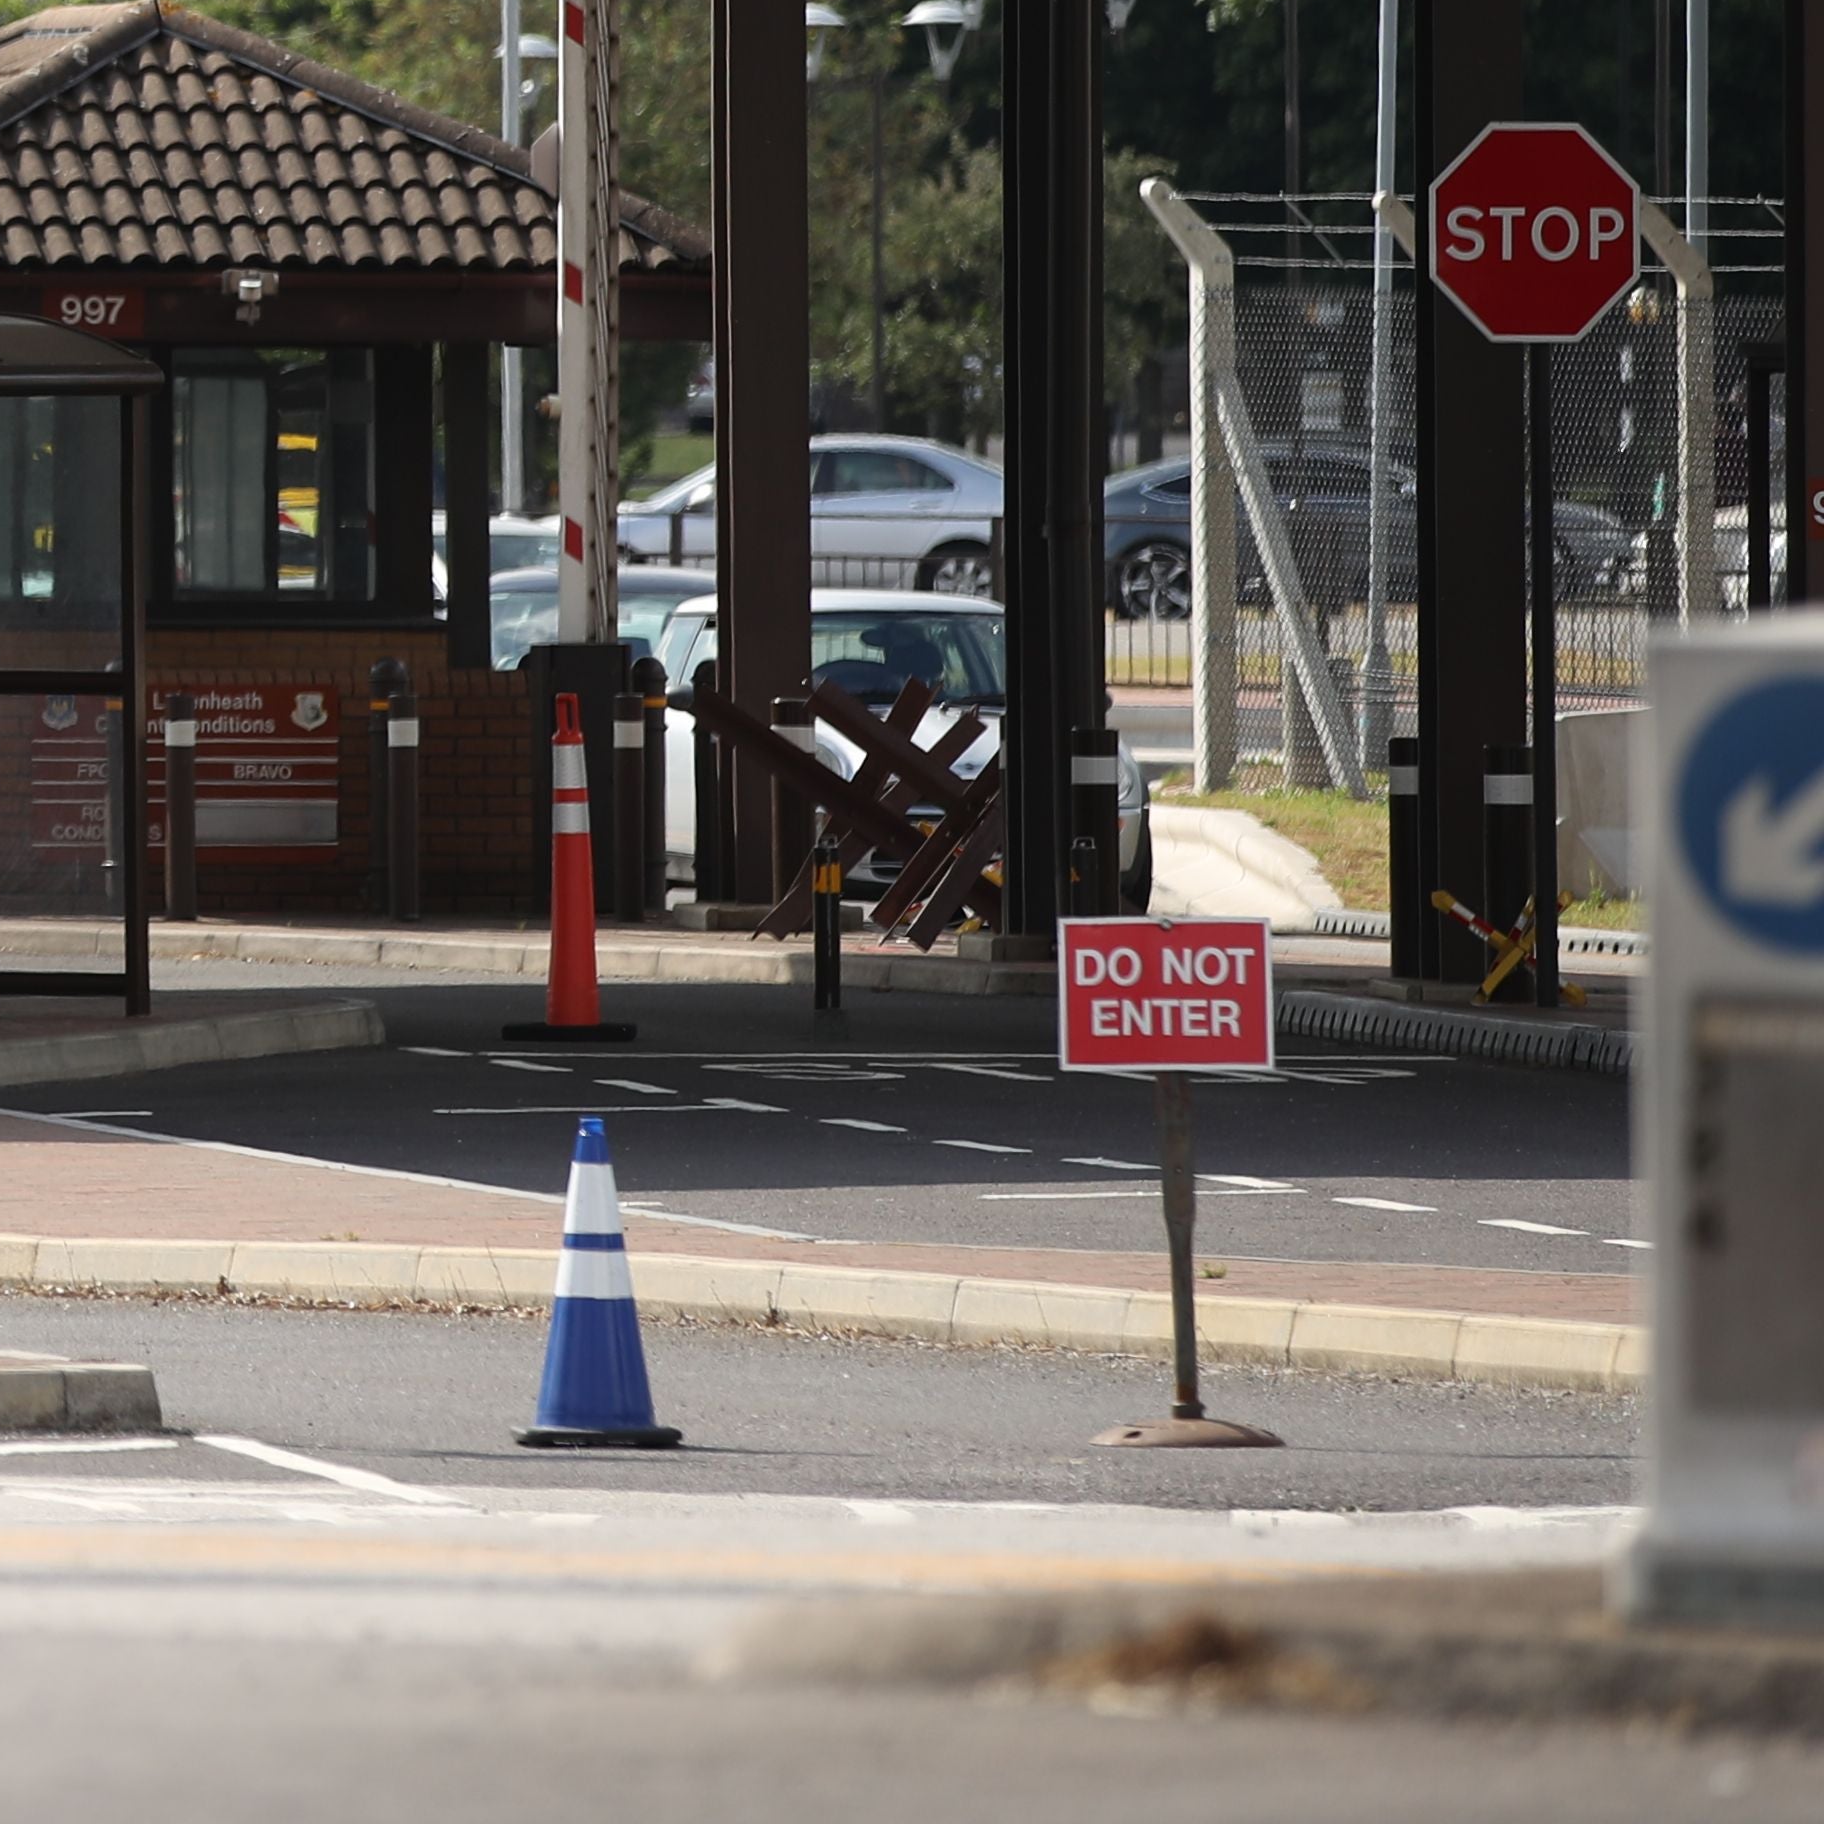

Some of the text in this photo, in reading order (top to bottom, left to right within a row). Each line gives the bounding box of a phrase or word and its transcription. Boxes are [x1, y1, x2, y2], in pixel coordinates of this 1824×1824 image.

[1445, 206, 1625, 262] STOP
[60, 296, 126, 325] 997
[233, 764, 293, 779] BRAVO
[1075, 947, 1255, 986] DO NOT
[1091, 999, 1241, 1037] ENTER
